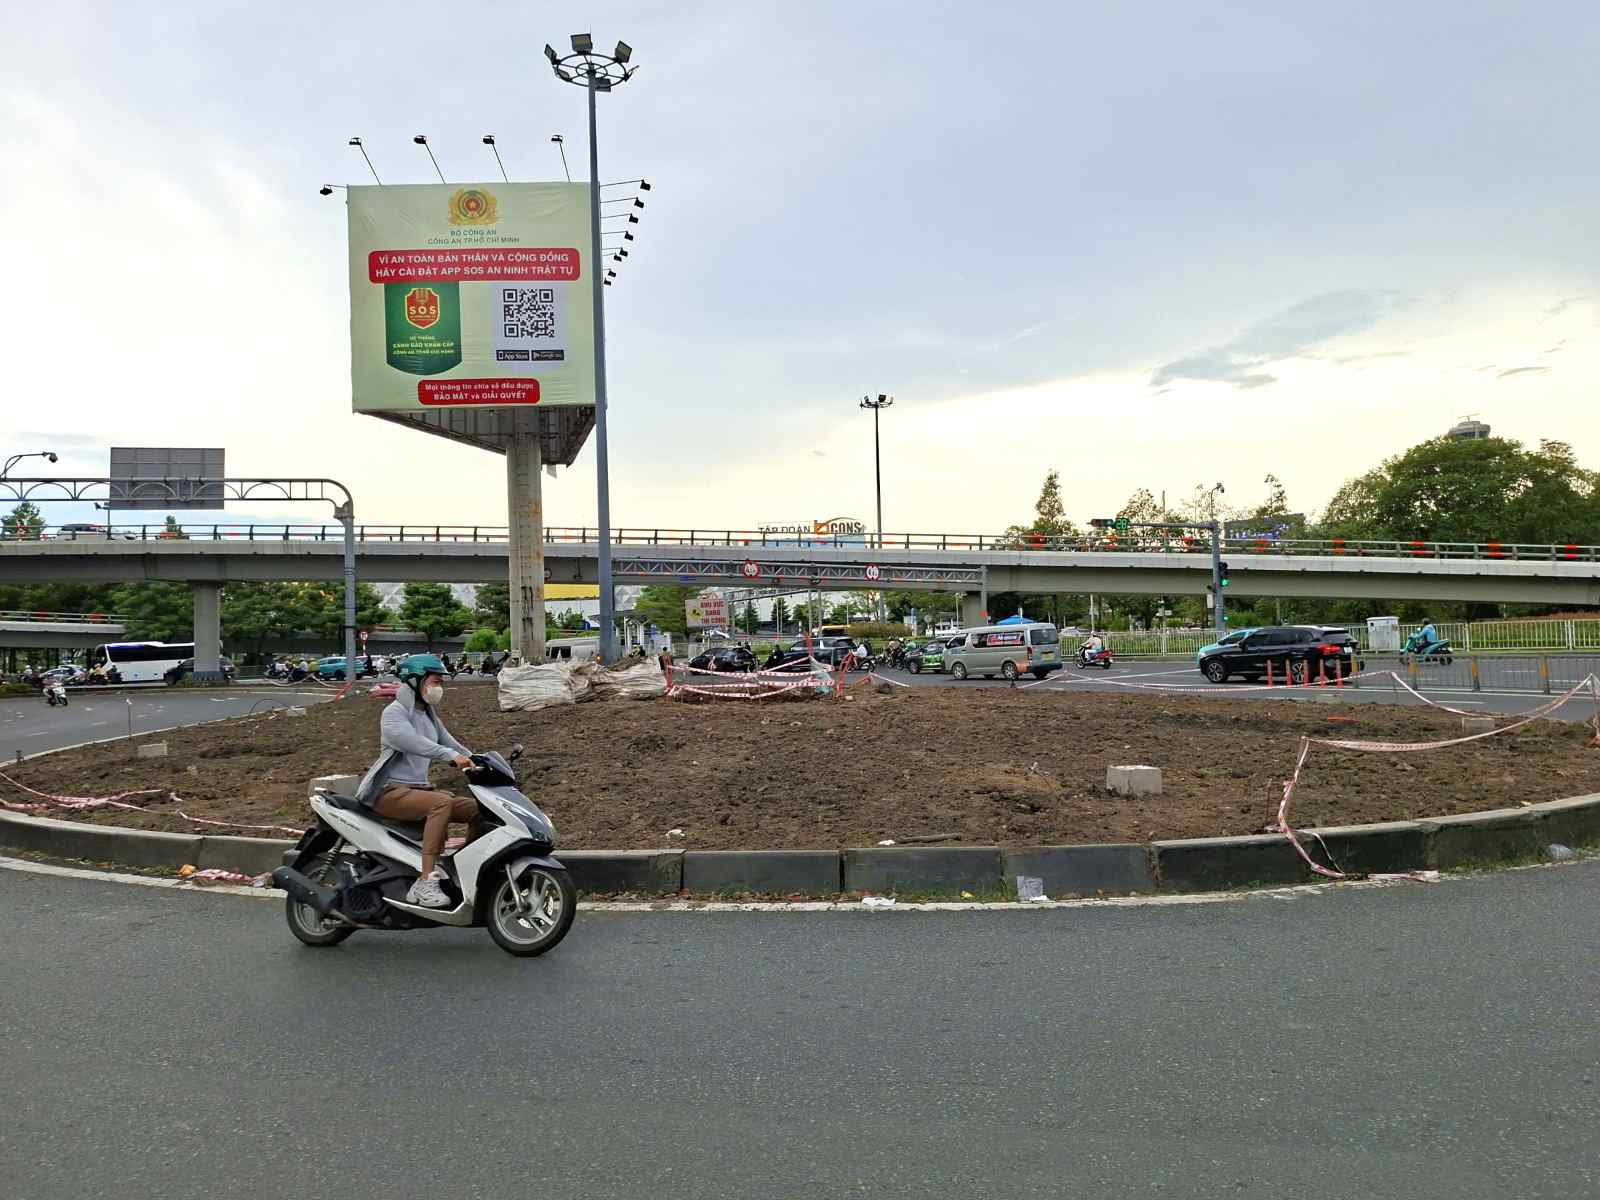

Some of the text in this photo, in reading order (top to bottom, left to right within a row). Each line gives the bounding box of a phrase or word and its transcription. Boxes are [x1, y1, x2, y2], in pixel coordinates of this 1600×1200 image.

[463, 228, 484, 236] CÔNG
[427, 237, 449, 245] CÔNG
[501, 236, 520, 244] MINH
[378, 251, 568, 265] VÌ AN TOÀN BẢN THÂN VÀ CÔNG ĐỒNG
[376, 267, 396, 277] HÃY
[399, 266, 416, 276] CÀI
[418, 266, 438, 277] ĐẶT
[440, 267, 461, 276] APP
[463, 266, 485, 275] SOS
[487, 266, 502, 274] AN
[504, 266, 528, 275] NINH
[531, 265, 557, 276] TRẬT
[409, 304, 437, 315] SOS
[504, 353, 515, 361] App
[425, 383, 438, 391] Mọi
[440, 383, 460, 391] thông
[462, 382, 472, 390] tin
[433, 391, 451, 401] BẢO
[452, 391, 470, 400] MẬT
[482, 390, 498, 400] GIẢI
[500, 390, 526, 400] QUYẾT
